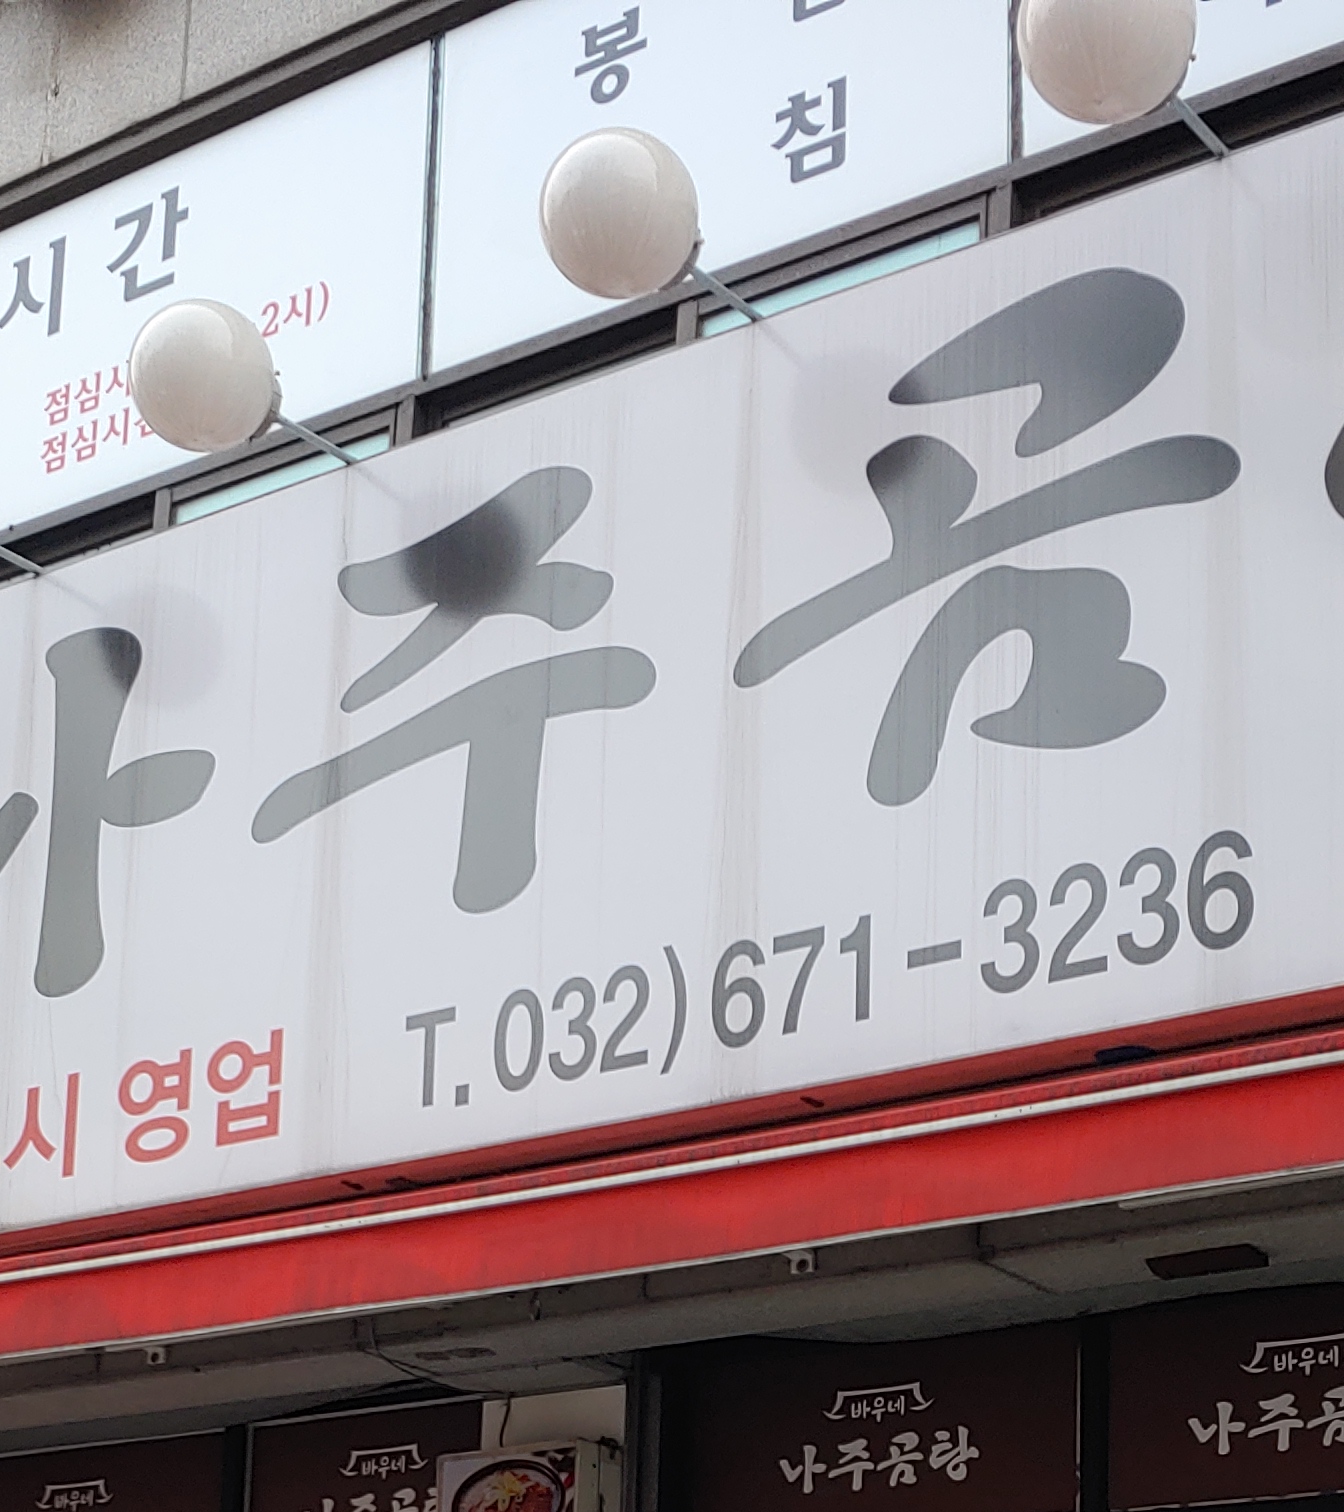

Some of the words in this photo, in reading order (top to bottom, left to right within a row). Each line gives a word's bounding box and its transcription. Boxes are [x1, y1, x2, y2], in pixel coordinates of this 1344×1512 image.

[117, 1026, 285, 1166] 영업
[1272, 1345, 1340, 1376] 바우네
[850, 1395, 907, 1423] 바우네
[360, 1452, 408, 1482] 바우네
[779, 1425, 981, 1494] 나주곰탕
